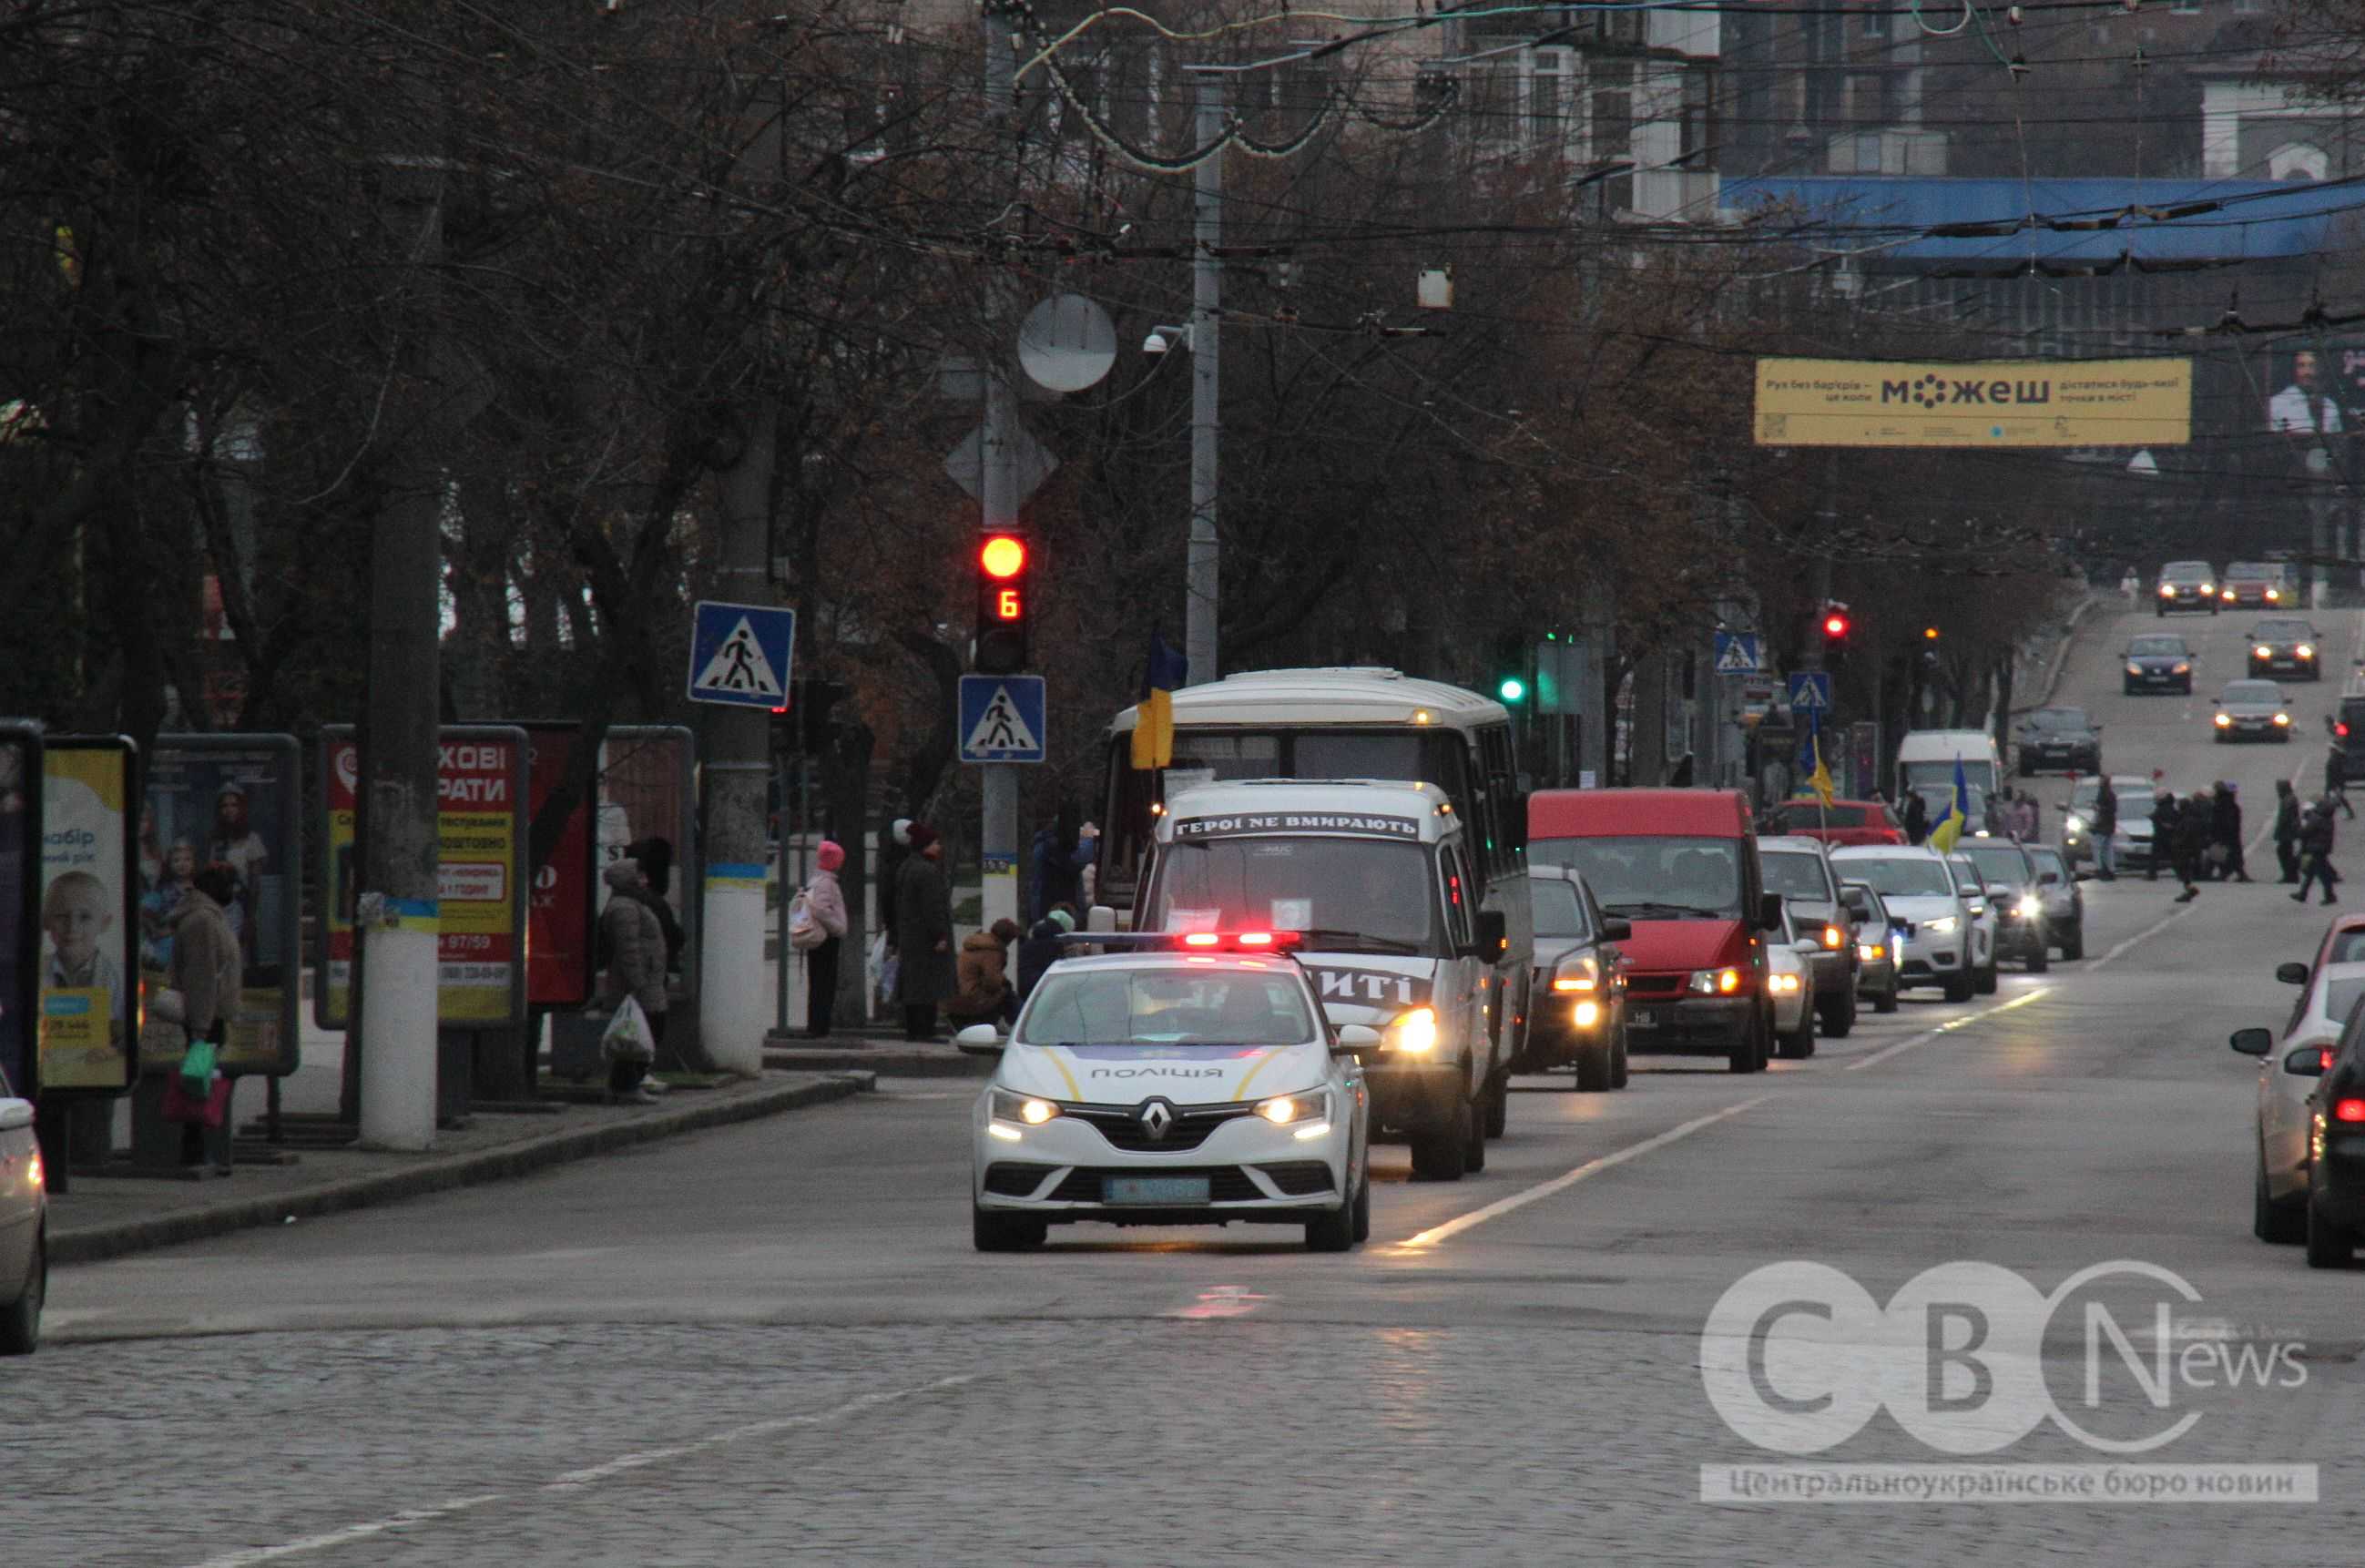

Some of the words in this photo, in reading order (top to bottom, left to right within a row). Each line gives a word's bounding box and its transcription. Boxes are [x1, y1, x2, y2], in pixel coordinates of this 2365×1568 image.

[1790, 379, 1811, 390] без
[998, 589, 1019, 618] 6
[1285, 815, 1417, 834] ВМИРАЮТЬ
[1090, 1066, 1224, 1079] ПОЛІЦІЯ
